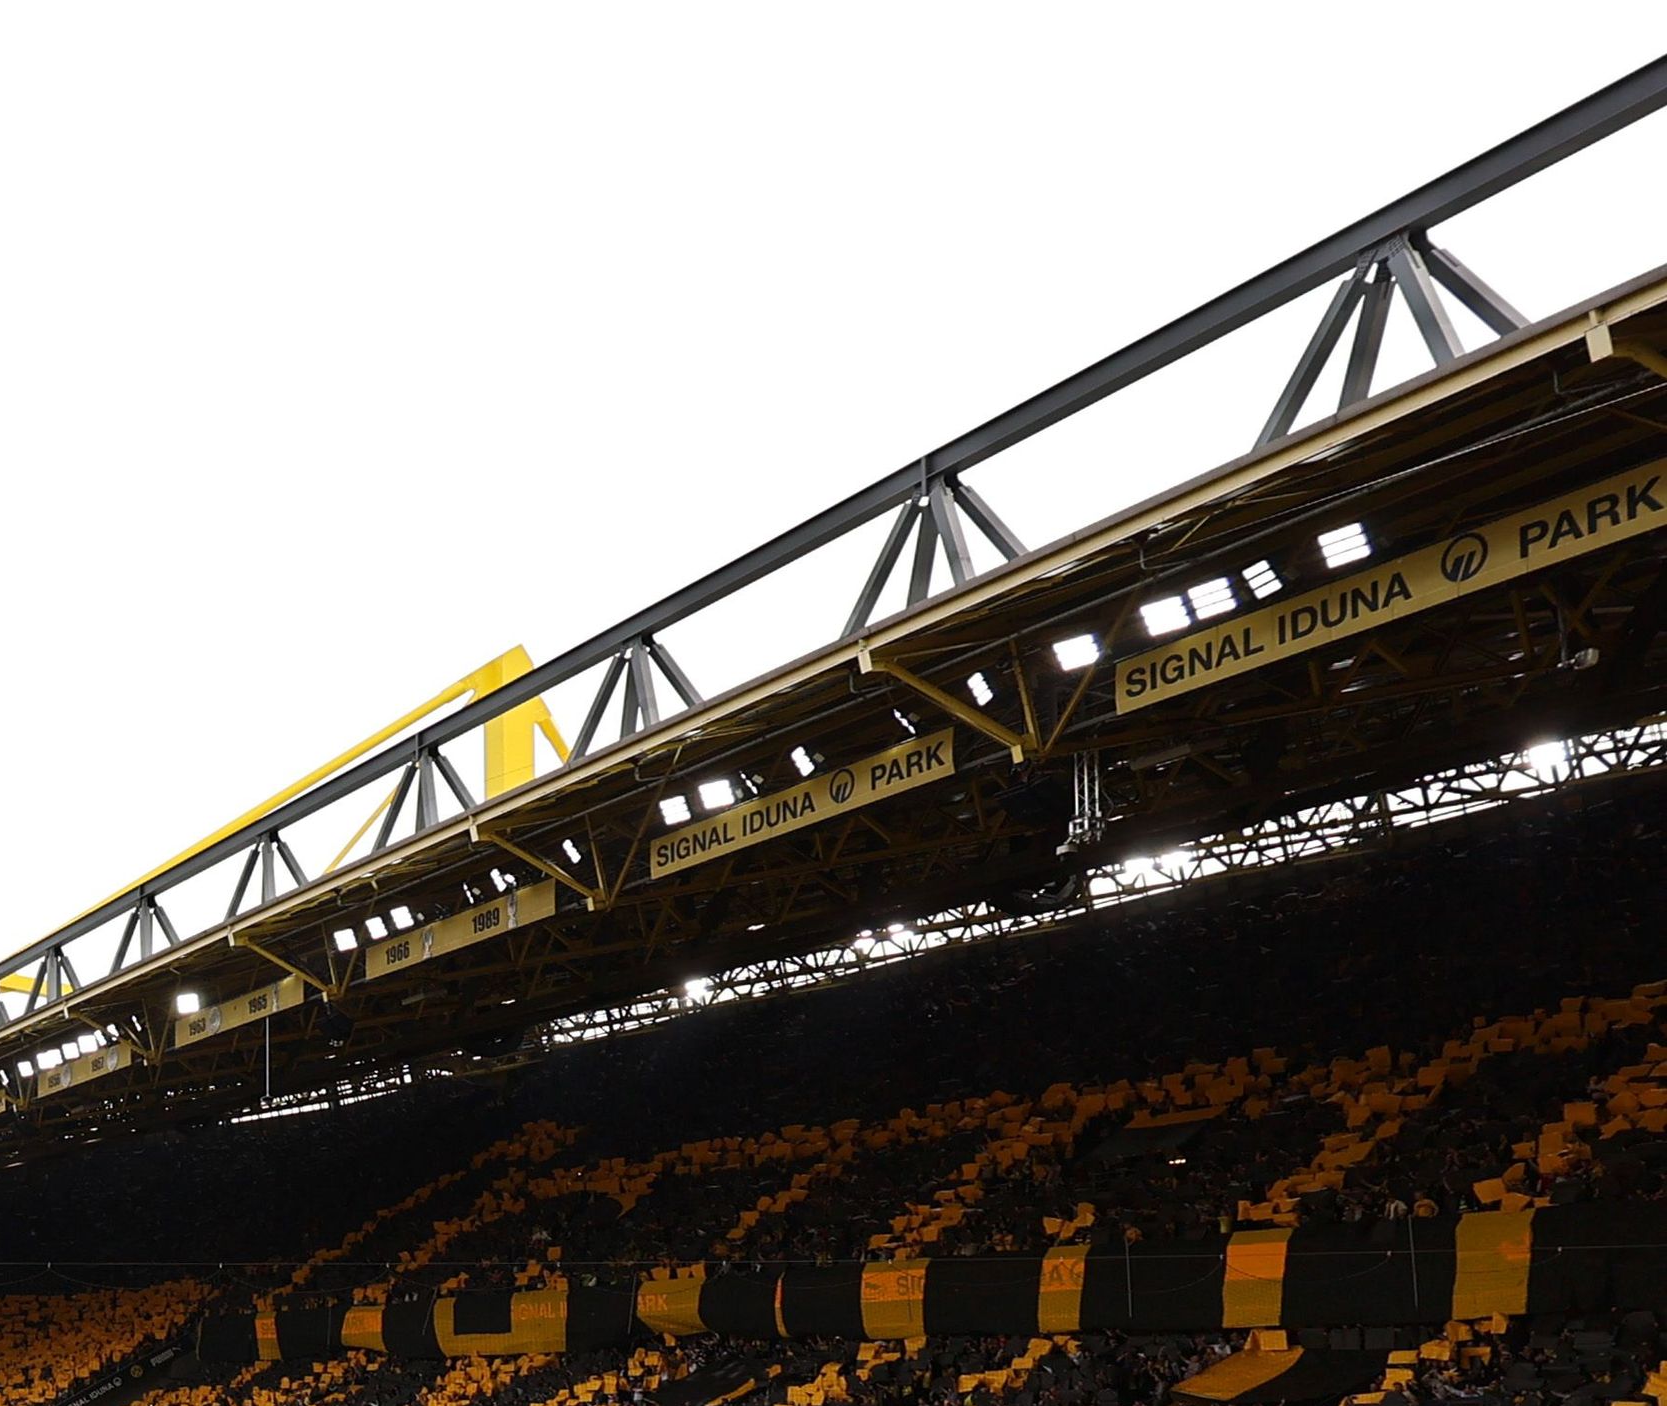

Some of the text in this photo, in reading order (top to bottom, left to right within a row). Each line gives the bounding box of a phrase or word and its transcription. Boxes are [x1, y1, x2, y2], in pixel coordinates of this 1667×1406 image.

[1125, 474, 1665, 698] SIGNAL IDUNA PARK
[656, 741, 945, 867] SIGNAL IDUNA PARK
[385, 942, 411, 965] 1966
[471, 907, 500, 935] 1989
